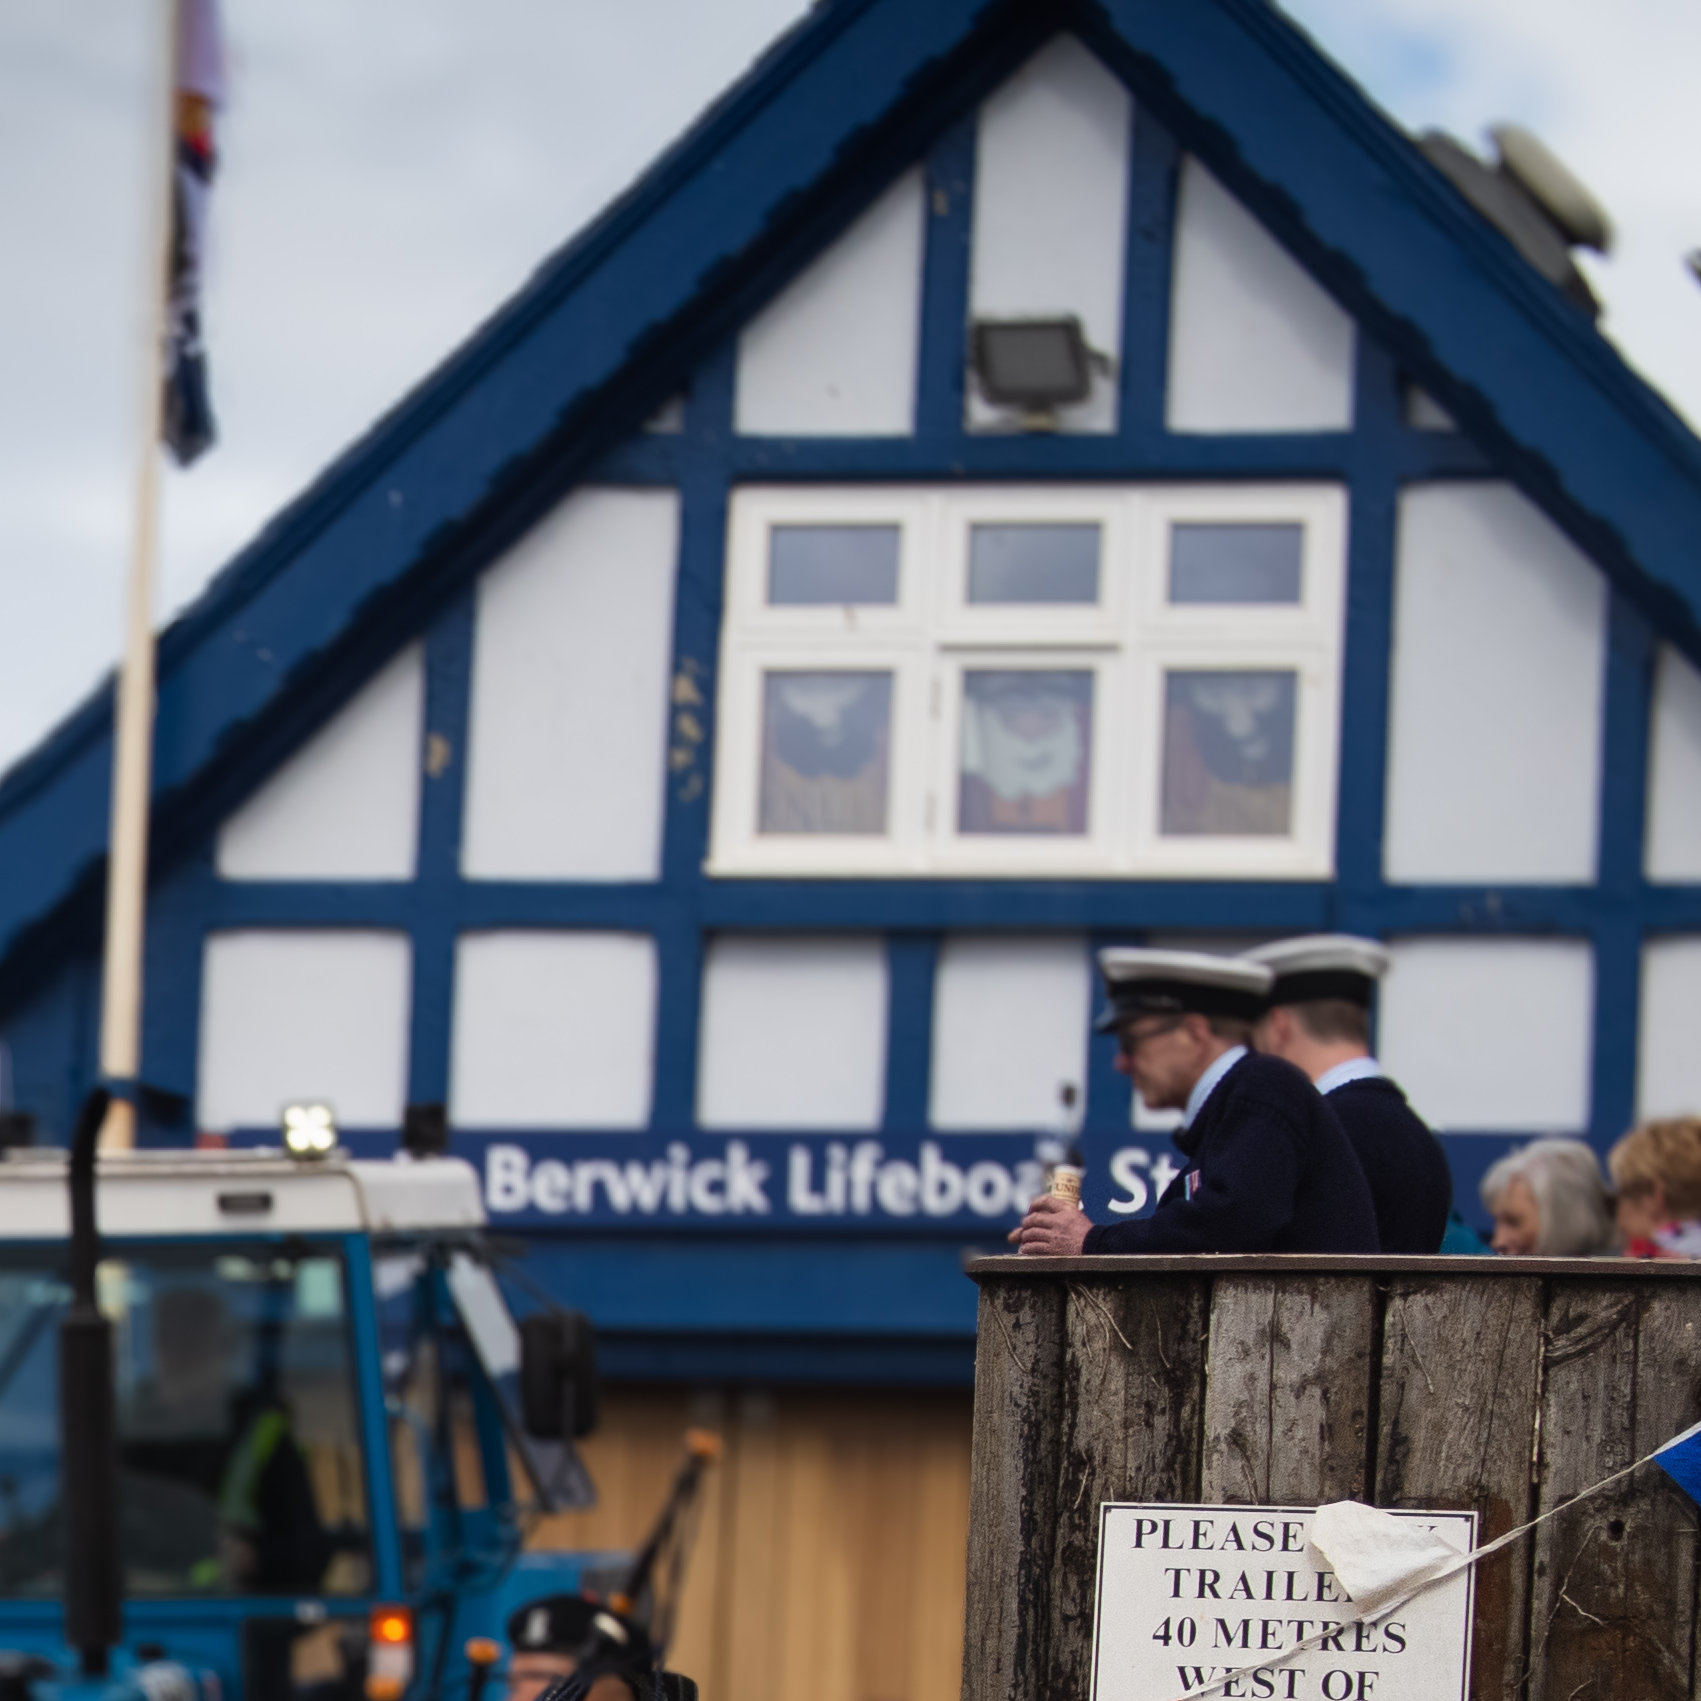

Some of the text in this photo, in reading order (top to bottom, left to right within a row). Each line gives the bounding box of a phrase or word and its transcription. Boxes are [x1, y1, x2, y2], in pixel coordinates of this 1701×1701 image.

[484, 1142, 772, 1215] Berwick
[1130, 1517, 1306, 1553] PLEASE
[1163, 1566, 1355, 1604] TRAILE
[1151, 1614, 1407, 1655] 40 METRES
[1176, 1664, 1306, 1701] WEST
